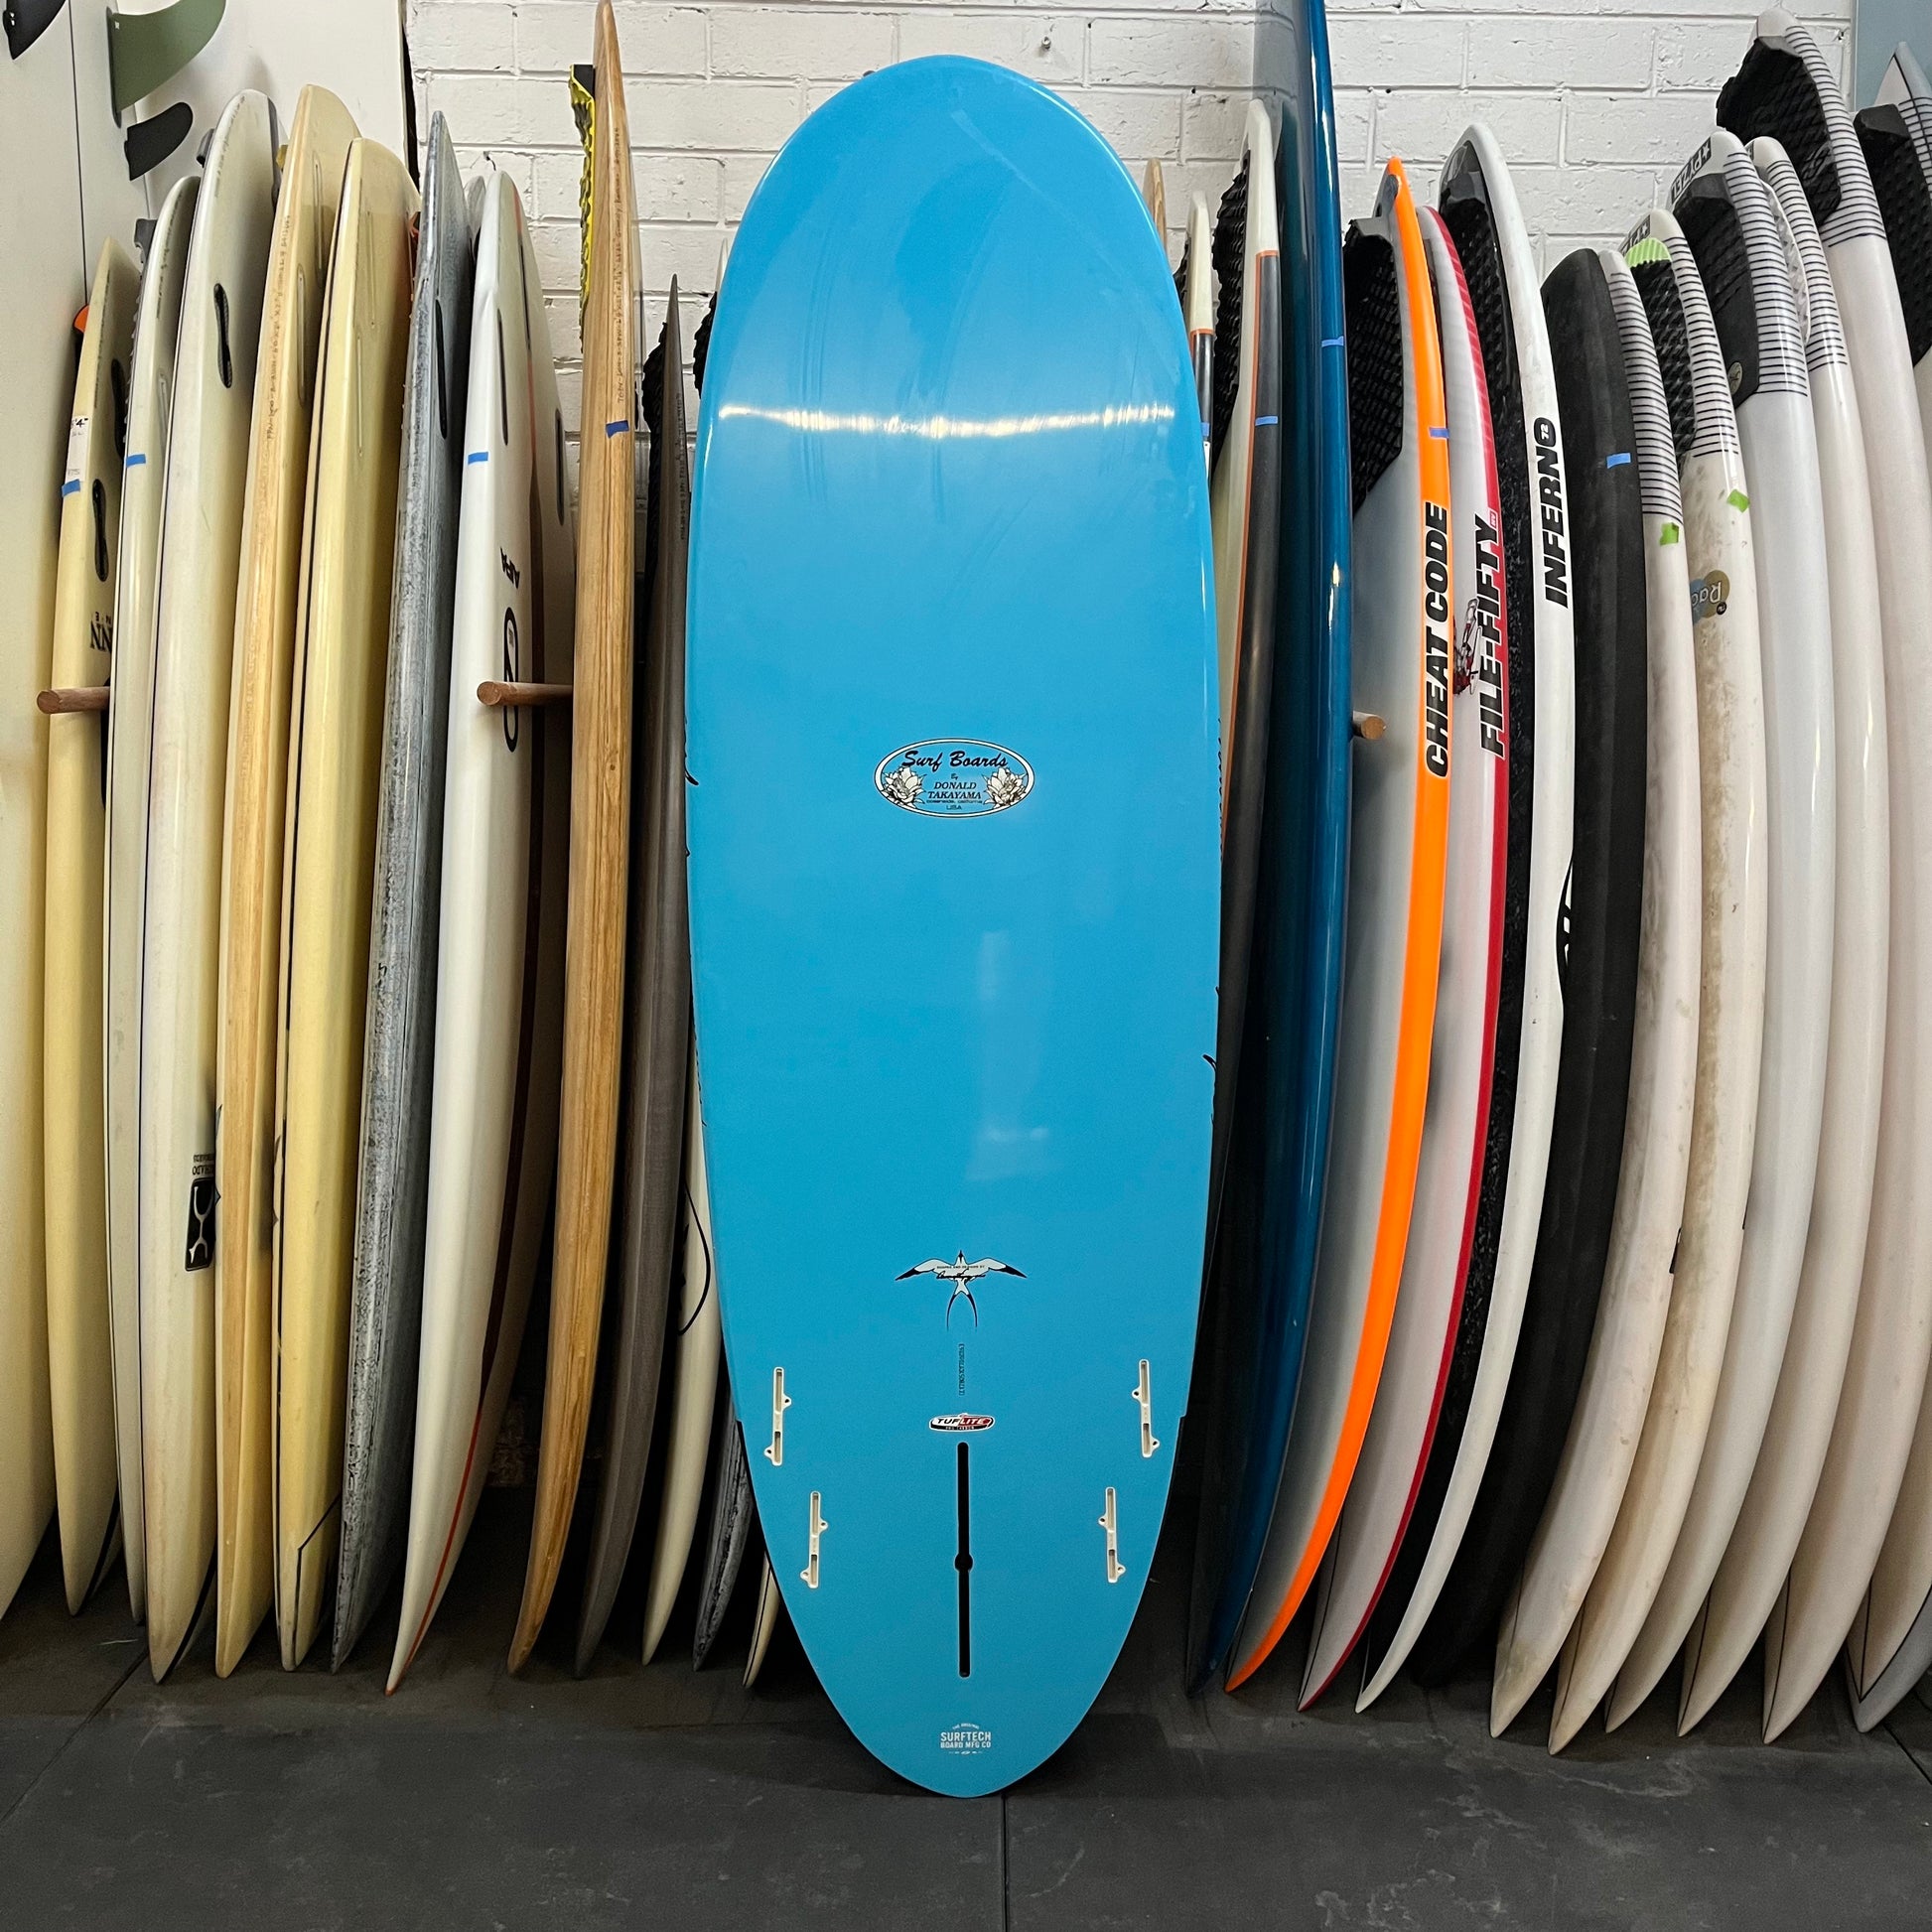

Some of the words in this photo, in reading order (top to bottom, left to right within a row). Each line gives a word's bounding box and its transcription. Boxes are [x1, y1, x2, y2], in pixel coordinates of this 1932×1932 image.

[1671, 149, 1704, 200] PYZEL
[1534, 417, 1569, 609] INFERNO
[1425, 501, 1449, 622] CODE
[1425, 625, 1449, 777] CHEAT
[901, 750, 943, 772] Surf
[949, 750, 1009, 767] Boards
[927, 790, 982, 799] TAKAYAMA
[933, 781, 977, 790] DONALD
[940, 1731, 992, 1741] SURFTECH
